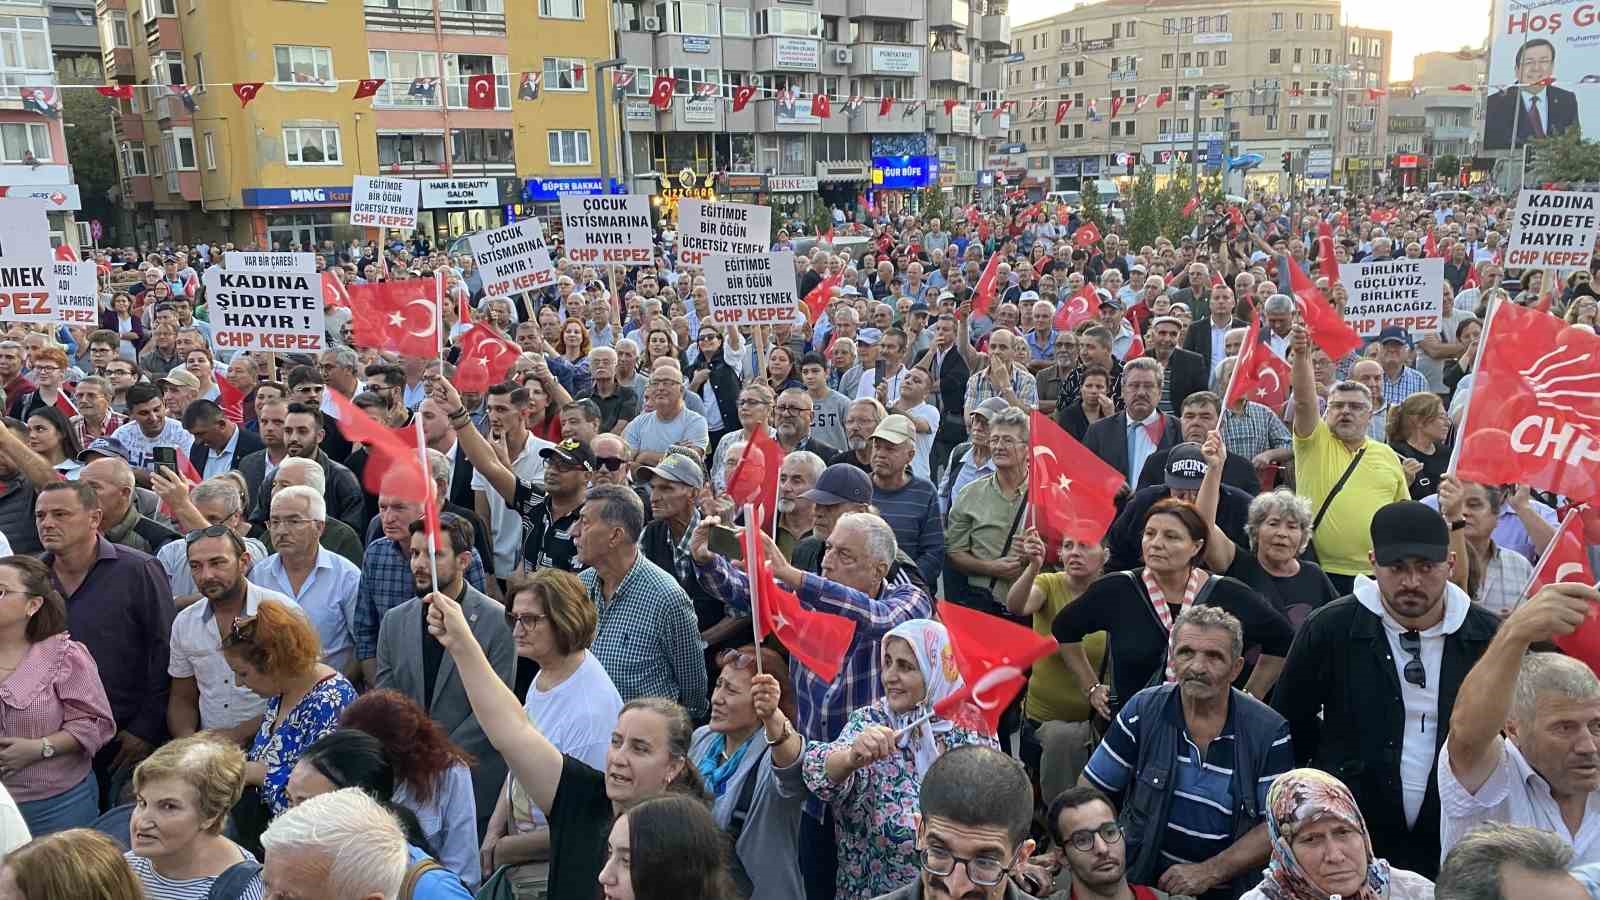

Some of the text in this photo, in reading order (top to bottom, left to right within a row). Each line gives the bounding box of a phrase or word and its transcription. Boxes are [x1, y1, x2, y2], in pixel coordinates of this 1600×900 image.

[1573, 4, 1600, 27] G
[290, 188, 325, 202] MNG
[1528, 194, 1594, 209] KADINA
[584, 198, 628, 215] ÇOCUK
[701, 204, 747, 220] EĞİTİMDE
[353, 213, 414, 228] CHP KEPEZ
[566, 212, 649, 228] İSTİSMARINA
[1520, 210, 1595, 230] ŞİDDETE
[487, 226, 523, 248] ÇOCUK
[700, 220, 747, 238] BİR ÖĞÜN
[586, 232, 632, 244] HAYIR !
[682, 234, 728, 252] ÜCRETSİZ
[1520, 232, 1586, 247] HAYIR !
[478, 238, 544, 265] İSTİSMARINA
[570, 248, 650, 262] CHP KEPEZ
[681, 251, 710, 264] CH
[1508, 249, 1589, 266] CHP KEPEZ
[244, 256, 256, 266] VAR
[496, 258, 534, 277] HAYIR !
[725, 256, 771, 272] EĞİTİMDE
[0, 266, 45, 287] MEK
[54, 264, 72, 276] ARESİ
[1362, 263, 1420, 276] BİRLİKTE
[220, 274, 309, 290] KADINA
[488, 270, 552, 296] CHP KEPEZ
[728, 273, 773, 288] BİR ÖĞÜN
[1354, 274, 1426, 290] GÜÇLÜYÜZ,
[216, 291, 316, 310] ŞİDDETE
[713, 291, 792, 306] ÜCRETSİZ YEMEK
[1361, 289, 1419, 302] BİRLİKTE
[58, 310, 95, 322] EPEZ
[224, 314, 310, 328] HAYIR !
[714, 308, 796, 322] CHP KEPEZ
[1380, 316, 1438, 331] KEPEZ
[216, 332, 320, 350] CHP KEPEZ
